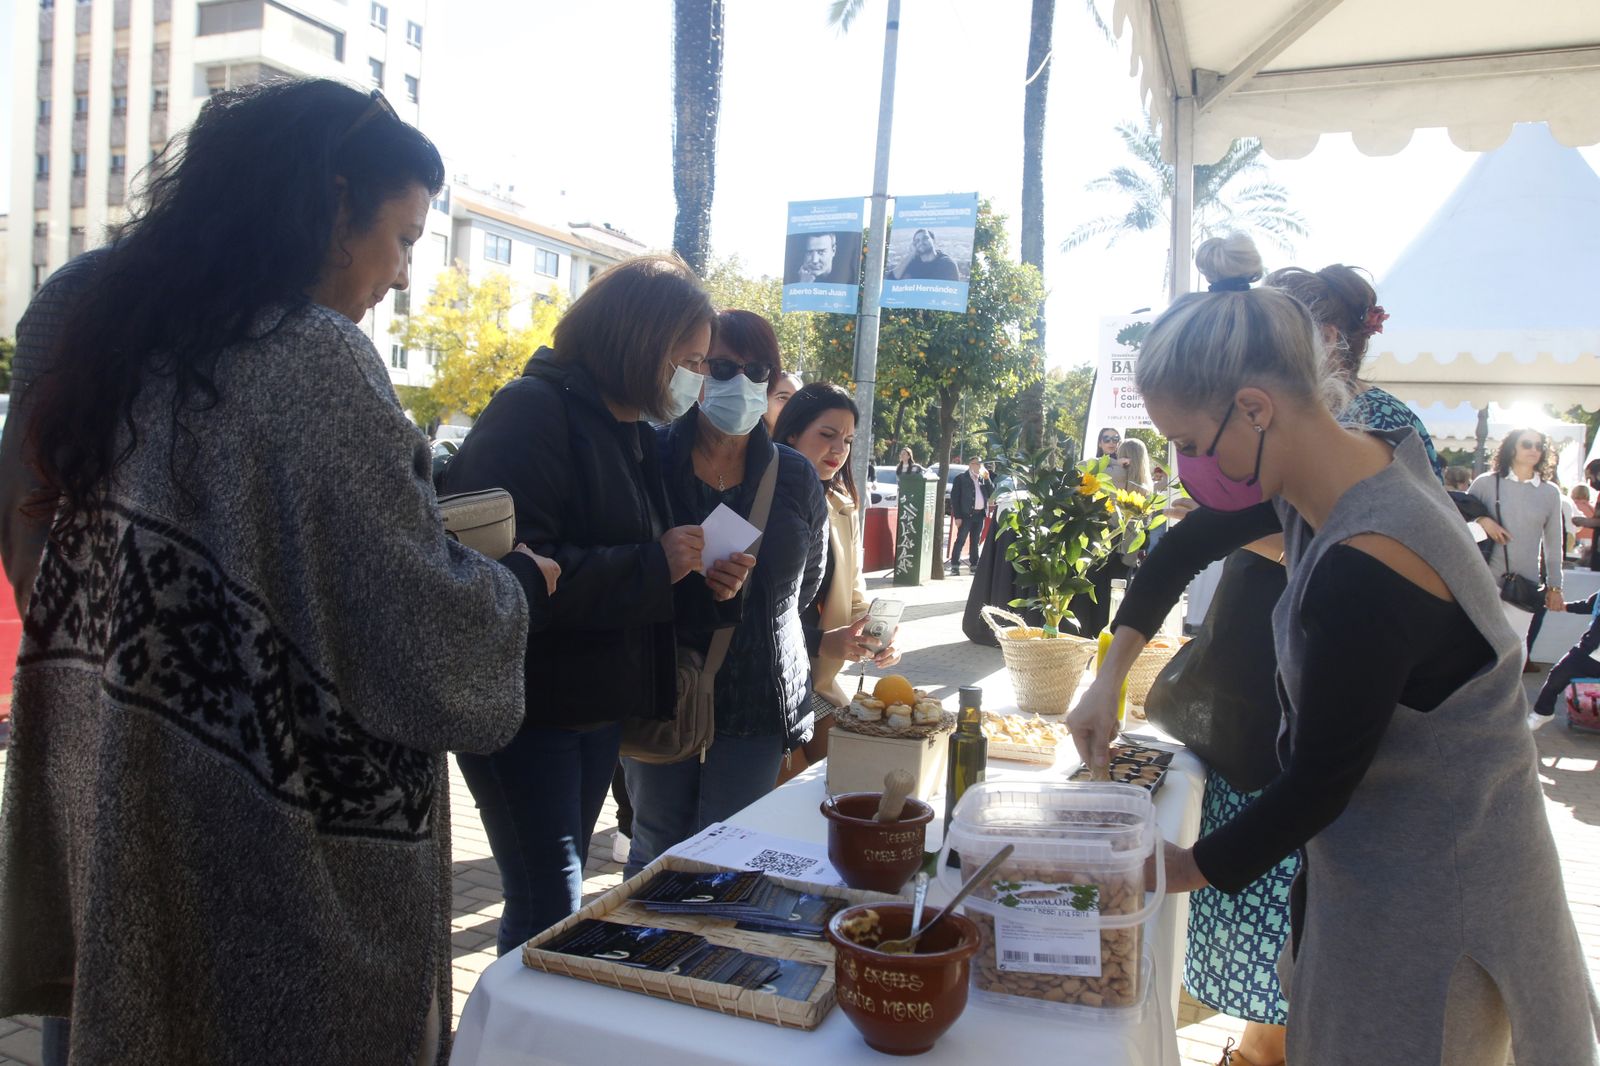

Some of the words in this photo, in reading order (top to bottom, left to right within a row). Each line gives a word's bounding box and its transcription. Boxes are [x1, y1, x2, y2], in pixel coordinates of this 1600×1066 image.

[789, 288, 812, 296] Alberto
[813, 287, 828, 296] San
[828, 289, 847, 297] Juan
[883, 999, 934, 1023] MARIA
